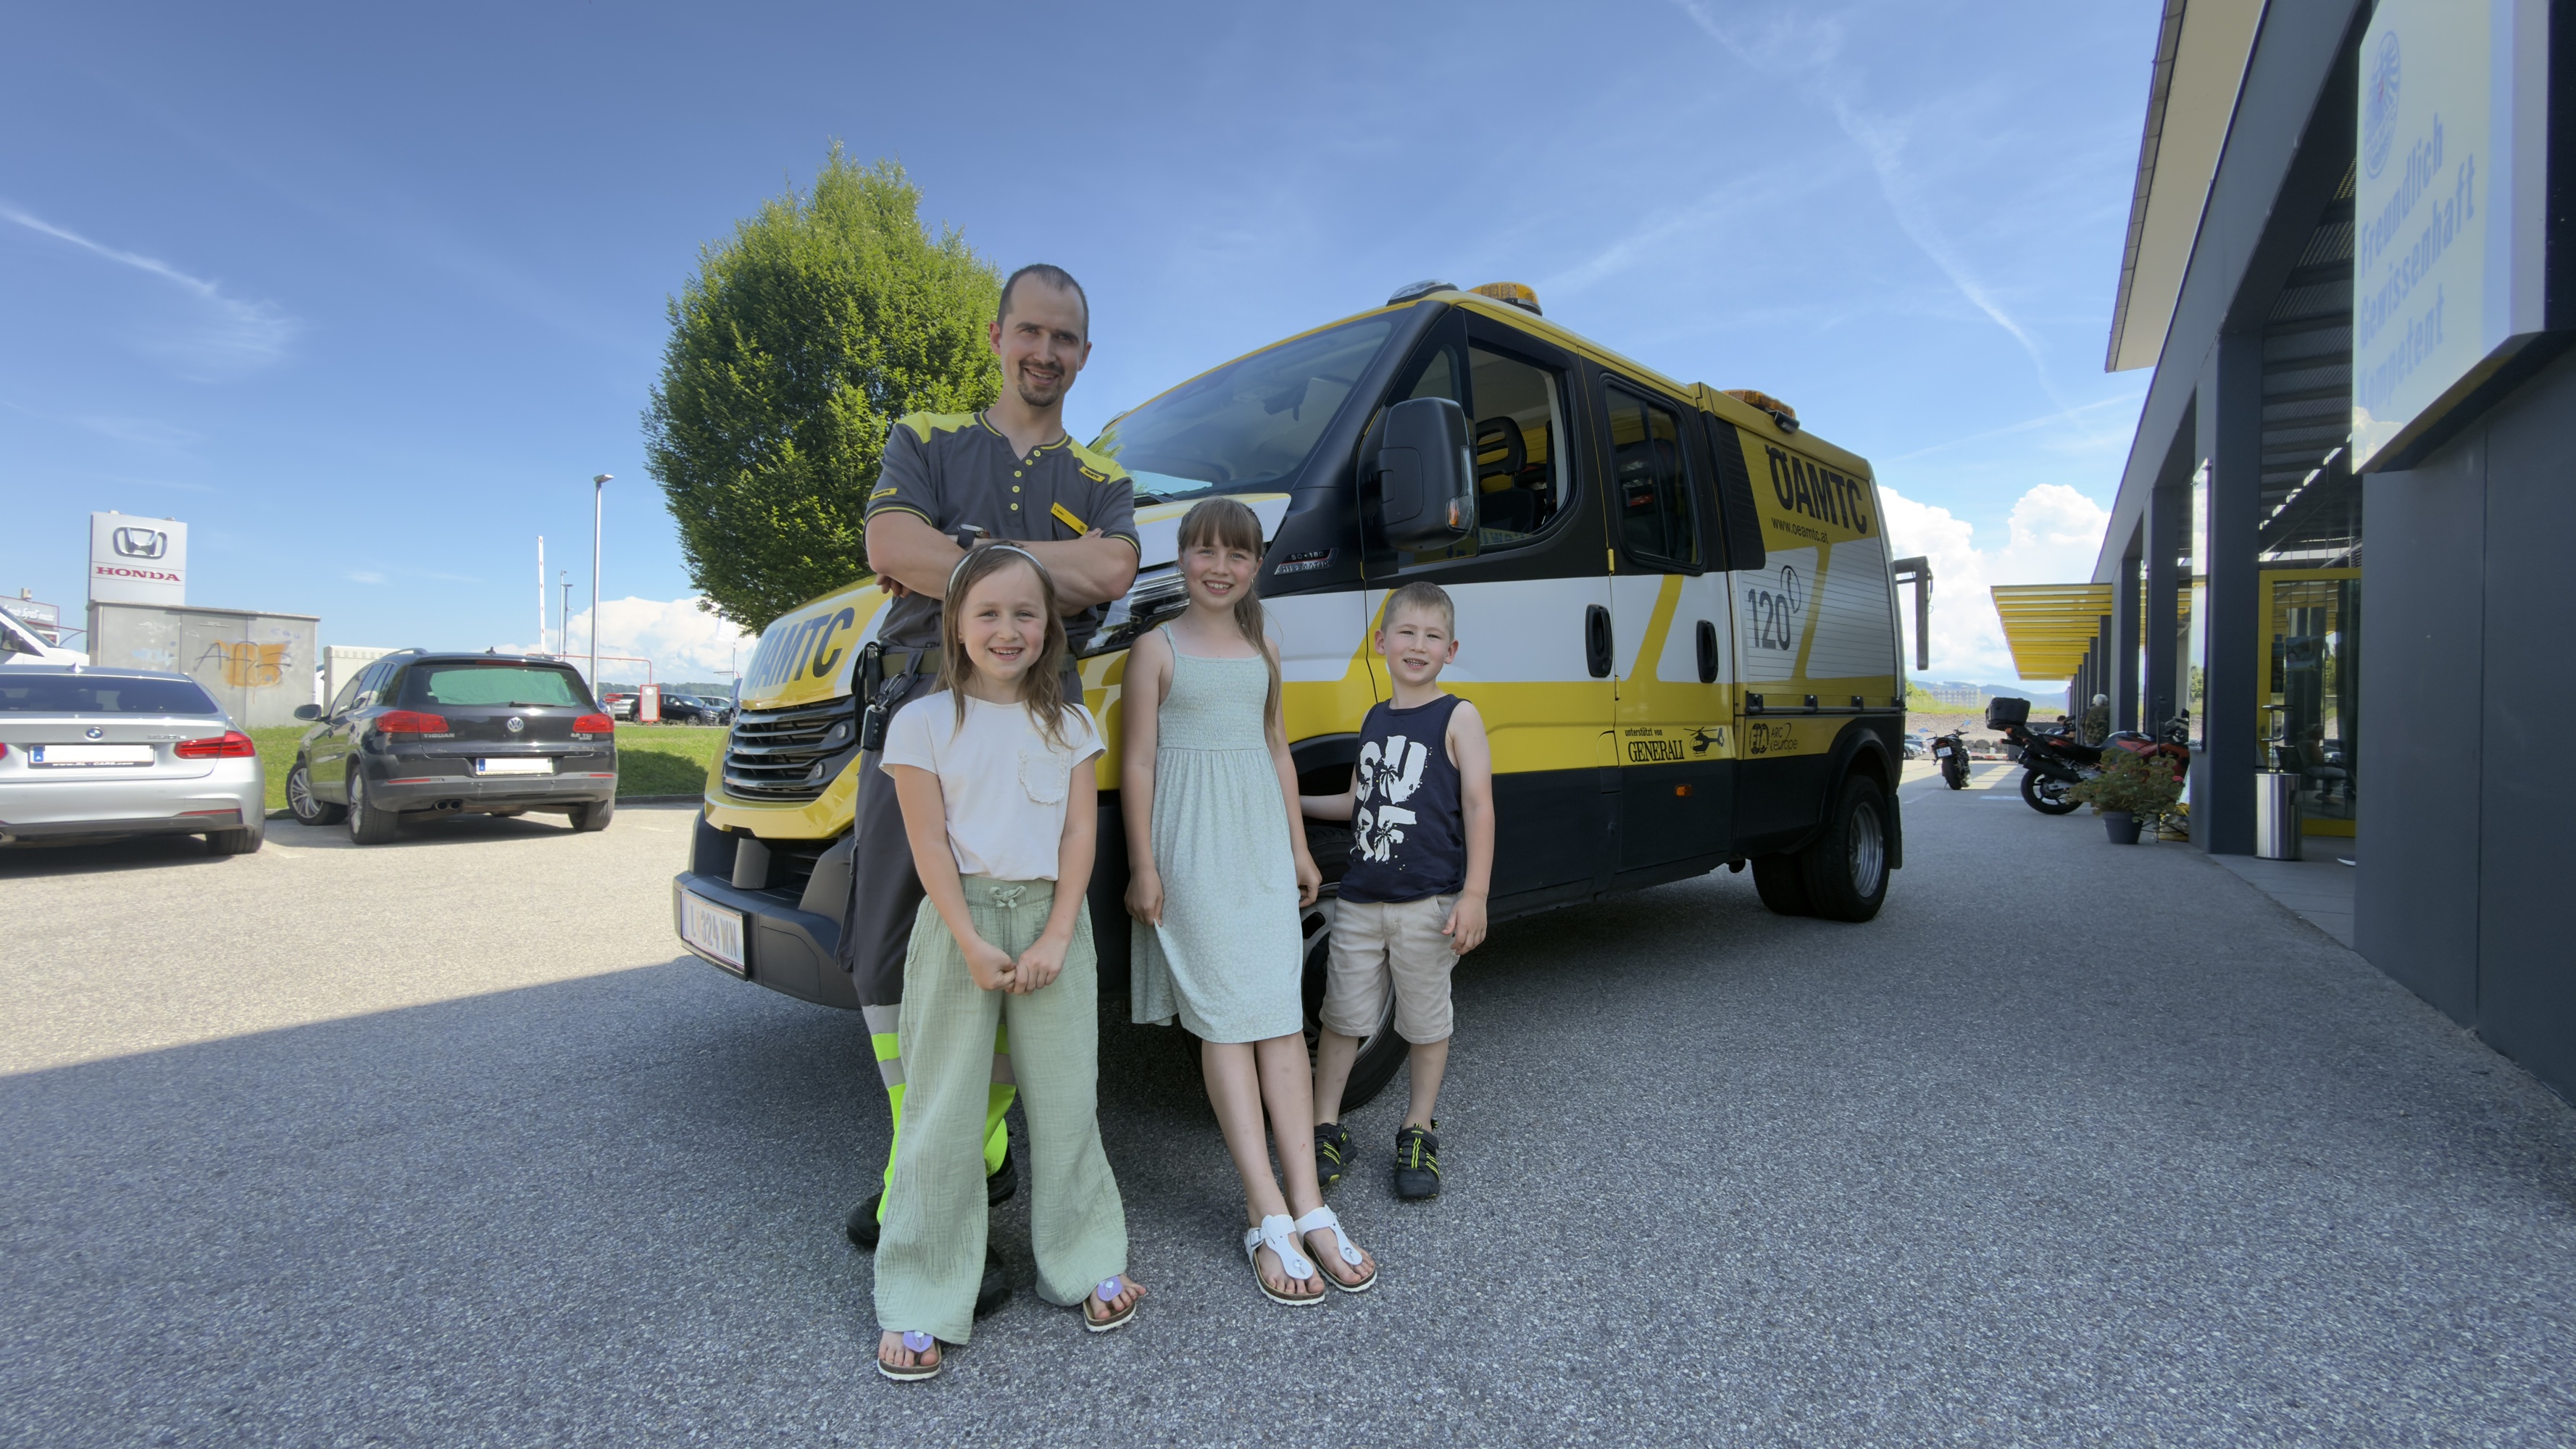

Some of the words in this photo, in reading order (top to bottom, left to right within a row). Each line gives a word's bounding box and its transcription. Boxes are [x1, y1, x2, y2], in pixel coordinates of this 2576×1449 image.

[2361, 112, 2444, 279] Freundlich
[2359, 154, 2475, 351] Gewissenhaft
[1764, 444, 1867, 535] ÖAMTC
[1771, 517, 1829, 544] www.oeamtc.at
[96, 567, 181, 582] HONDA
[1748, 588, 1791, 651] 120
[1625, 727, 1653, 737] unterstützt
[1771, 727, 1783, 738] ARC
[1627, 740, 1685, 762] GENERALI
